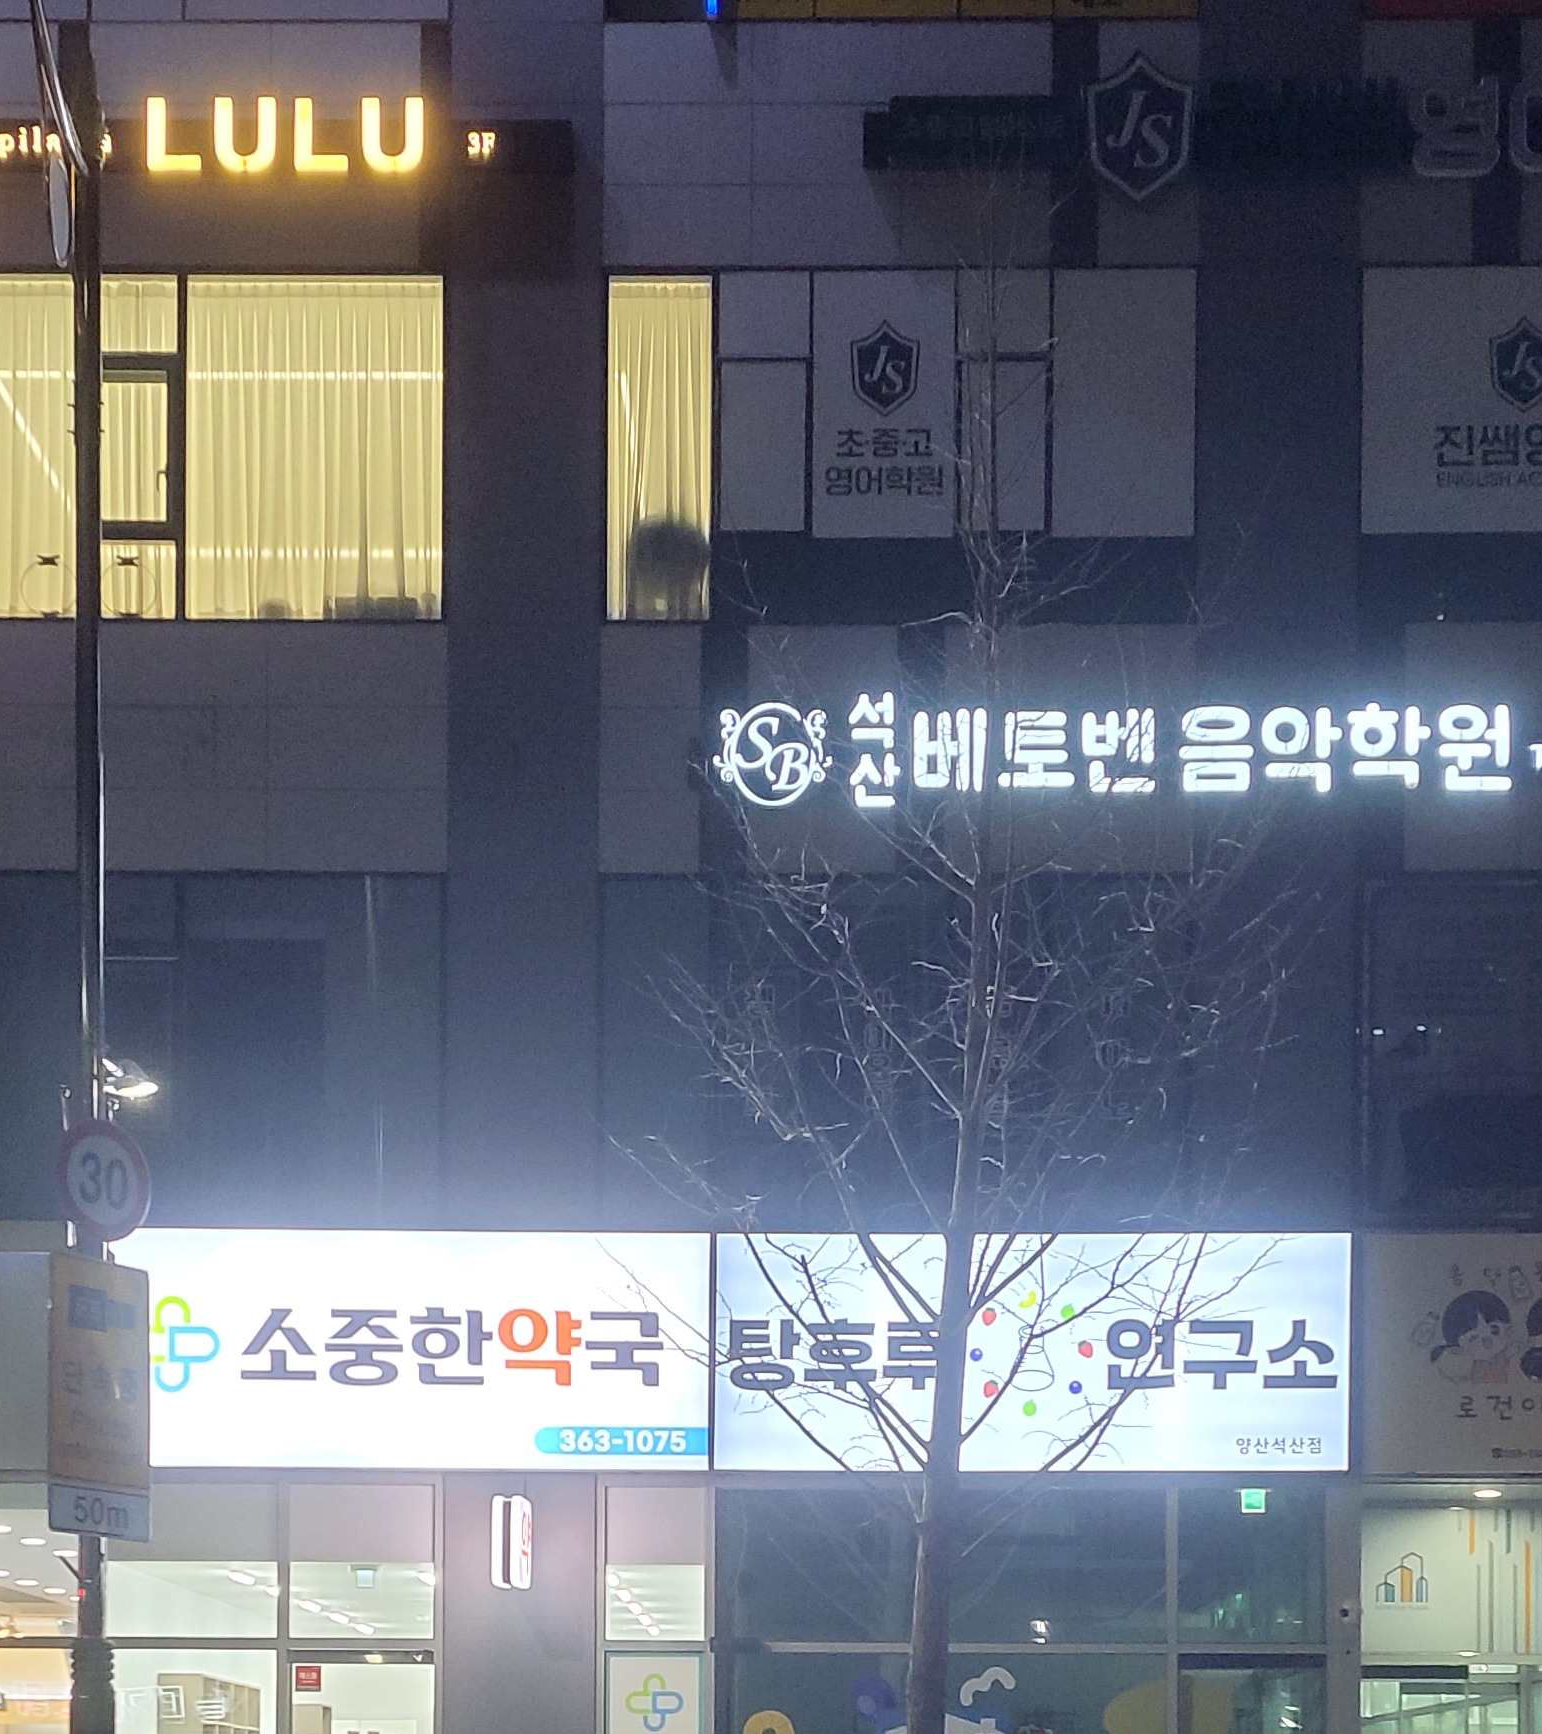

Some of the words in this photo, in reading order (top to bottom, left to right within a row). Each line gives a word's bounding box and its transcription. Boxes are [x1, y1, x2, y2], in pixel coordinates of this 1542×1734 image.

[146, 96, 425, 173] LULU
[824, 464, 945, 497] 영어학원
[1436, 470, 1512, 488] ENGLISH
[911, 702, 1159, 796] 베토벤
[1178, 701, 1514, 796] 음악학원
[76, 1151, 130, 1212] 30
[239, 1306, 665, 1388] 소중한약국
[1105, 1317, 1339, 1391] 연구소
[559, 1428, 687, 1454] 363-1075
[1234, 1435, 1324, 1456] 양산석산점
[72, 1496, 131, 1532] 50m
